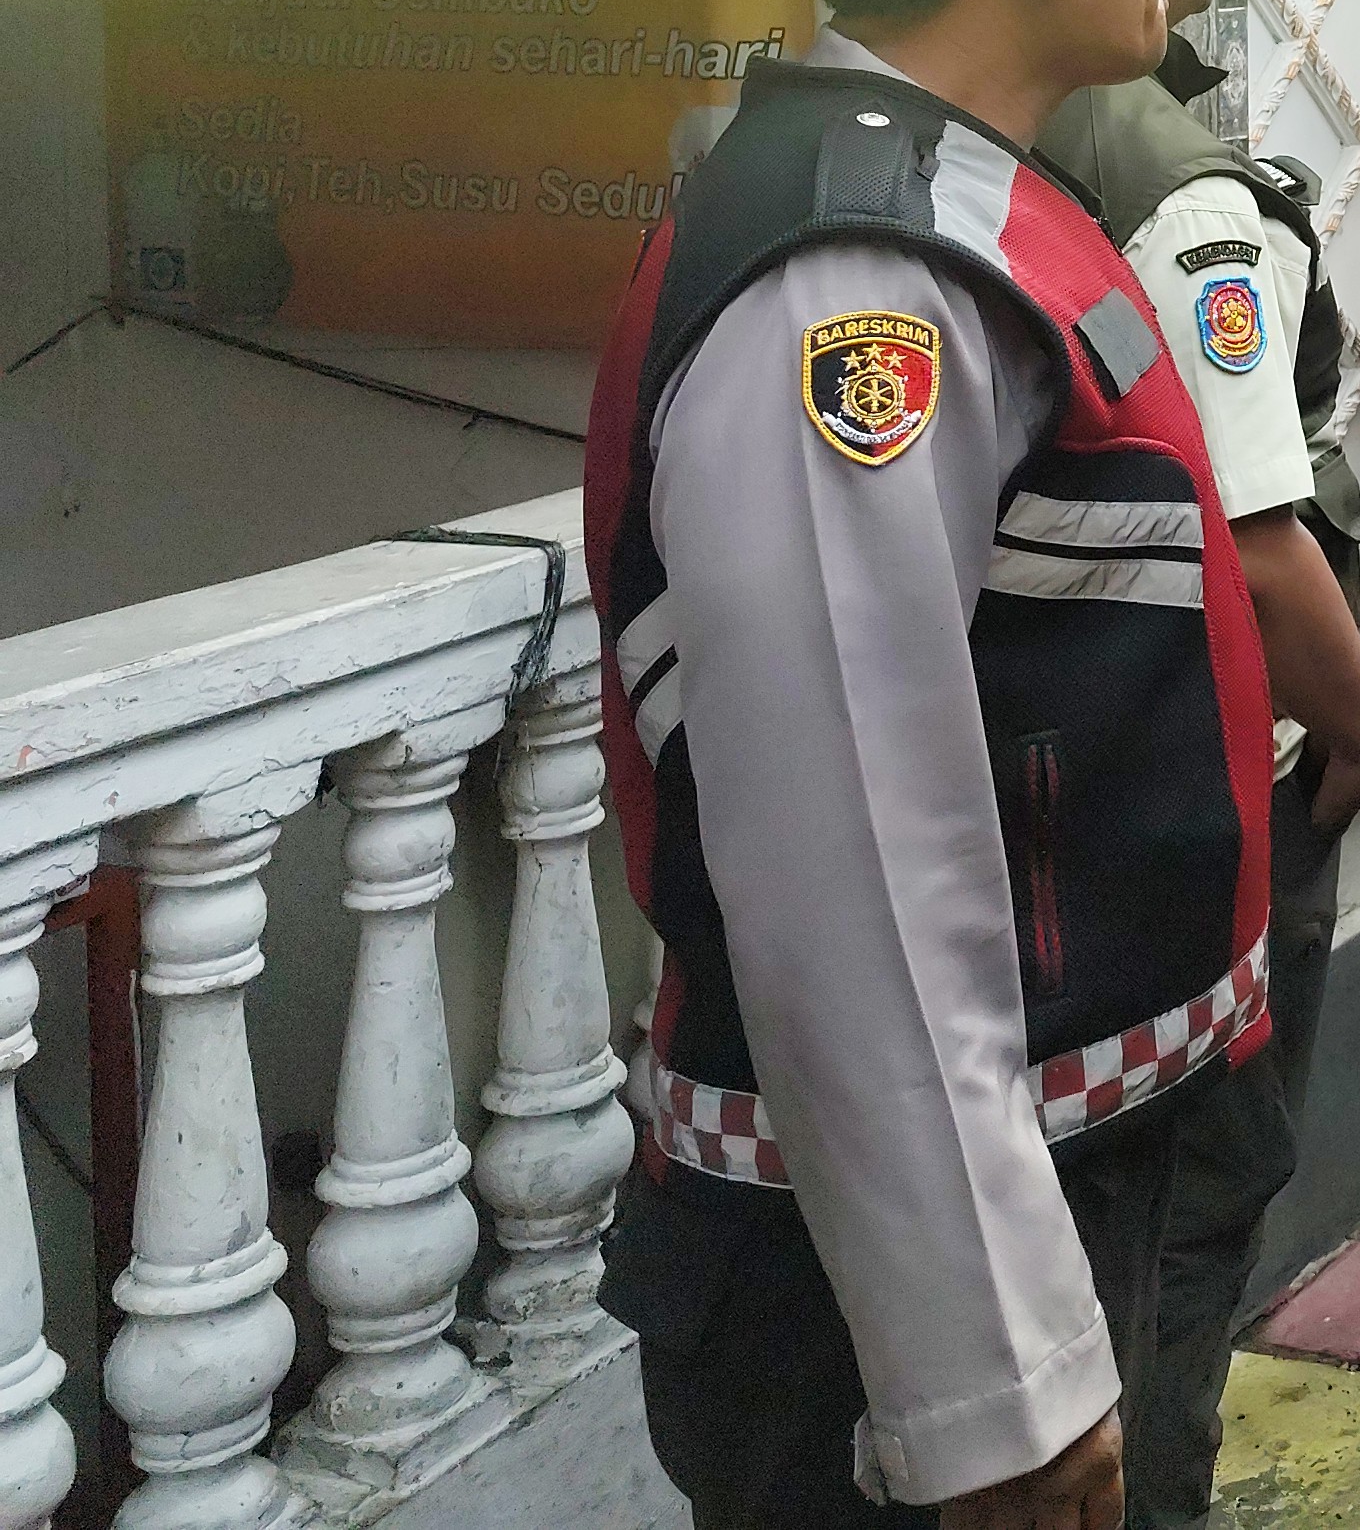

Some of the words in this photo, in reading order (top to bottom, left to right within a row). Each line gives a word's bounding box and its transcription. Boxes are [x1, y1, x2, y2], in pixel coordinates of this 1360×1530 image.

[181, 16, 210, 63] &
[227, 20, 474, 72] kebutuhan
[174, 95, 302, 145] Sedia
[537, 166, 686, 221] Sedu
[816, 318, 930, 346] BARESKRIM
